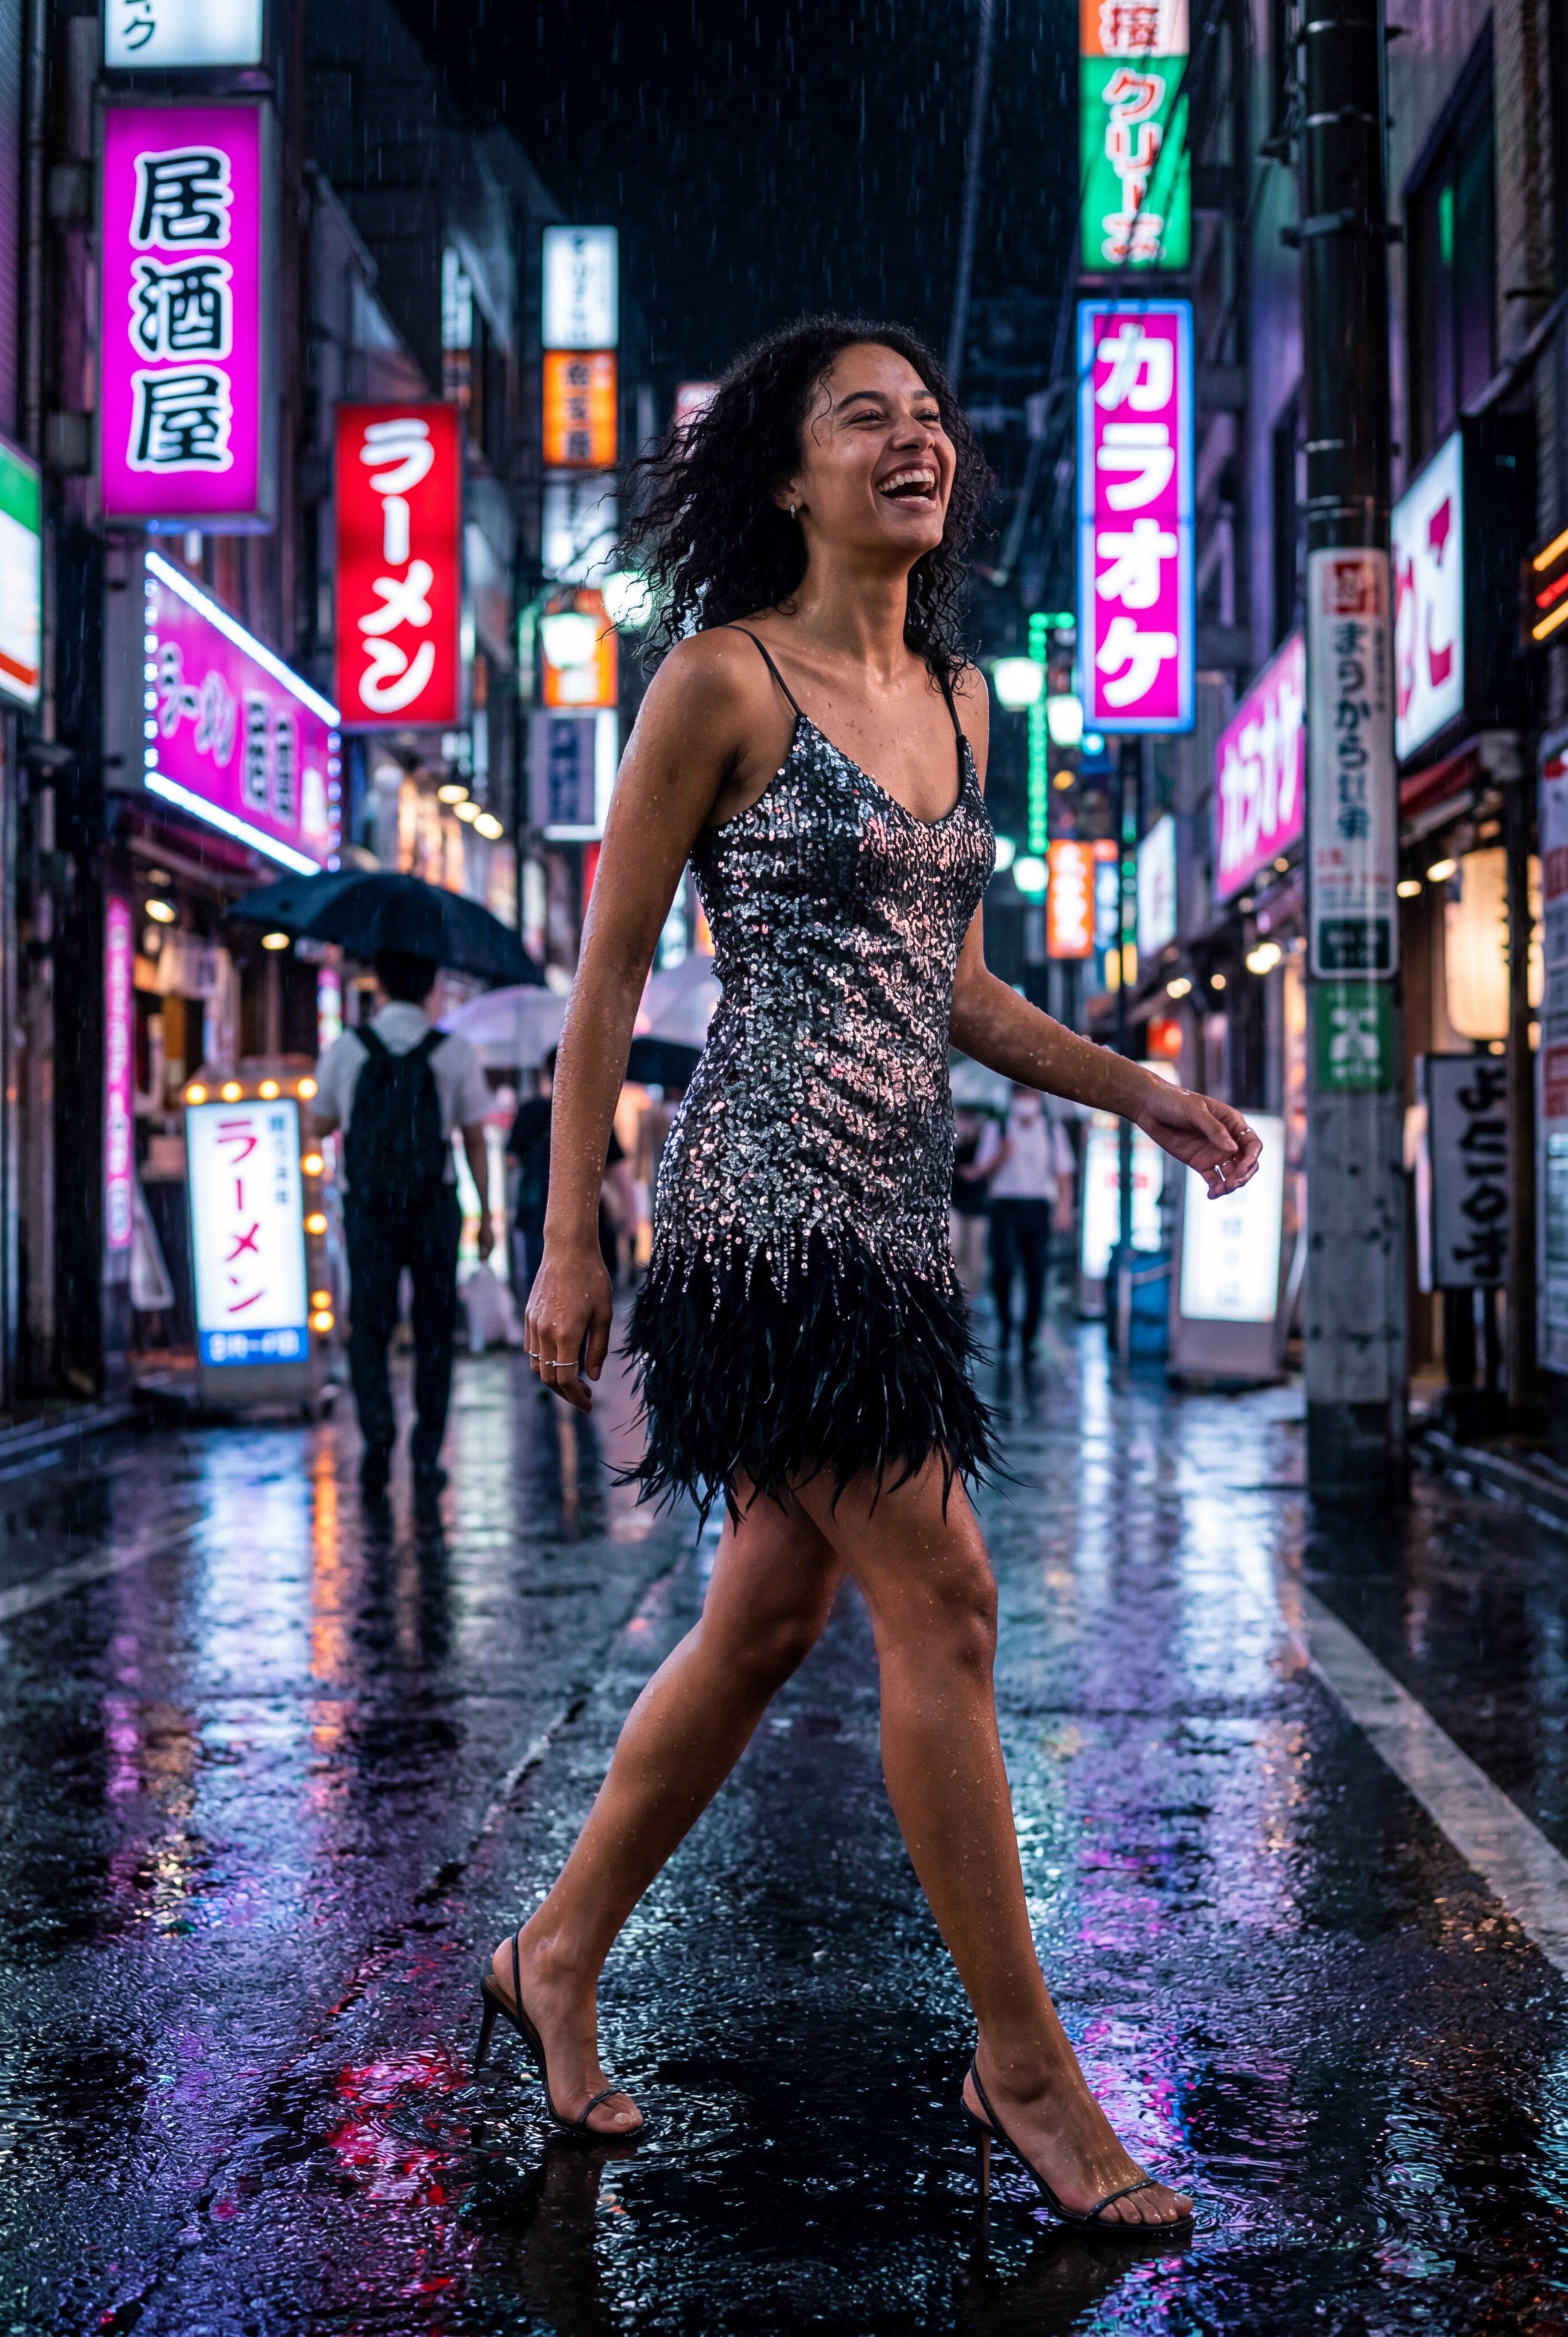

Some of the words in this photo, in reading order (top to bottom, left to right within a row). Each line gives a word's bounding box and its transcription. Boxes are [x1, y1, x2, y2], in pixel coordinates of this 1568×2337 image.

[128, 147, 233, 473] 居酒屋
[358, 418, 435, 714] ラーメン
[1094, 324, 1178, 708] カラオケ
[217, 1118, 263, 1312] ラーメン
